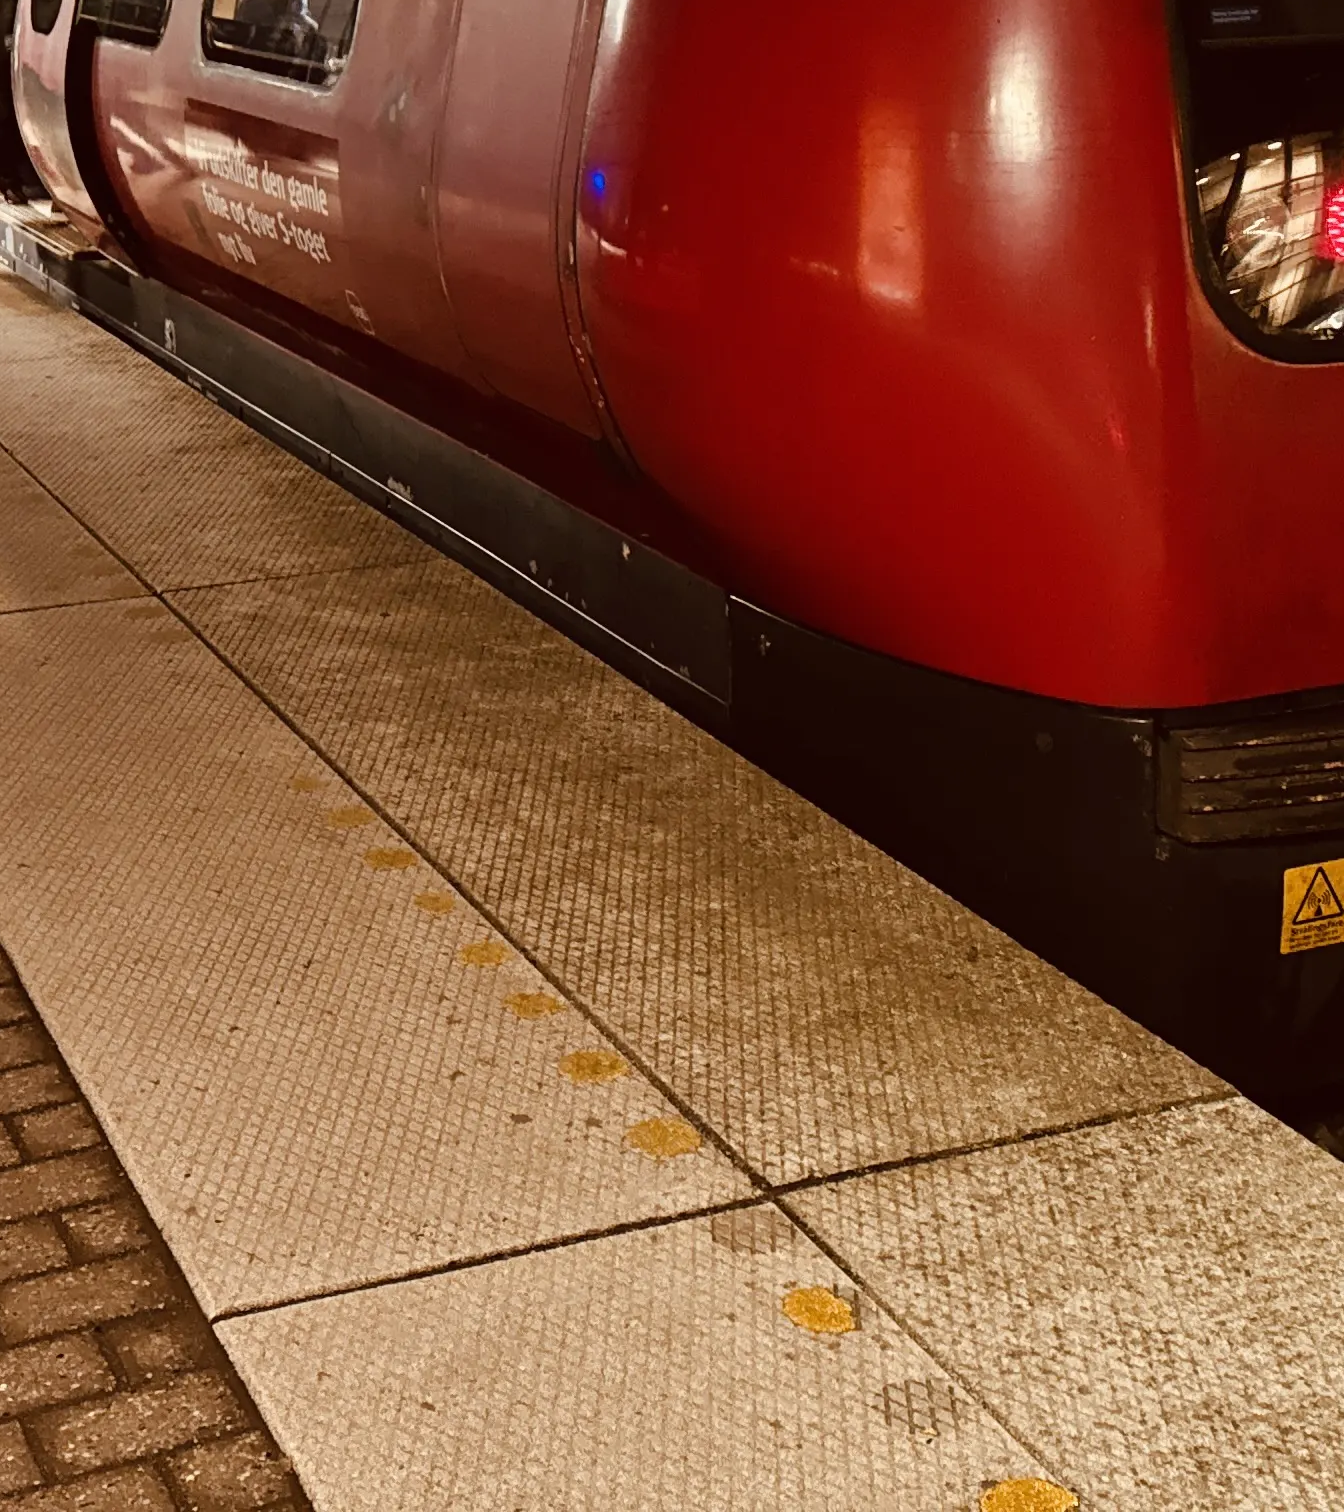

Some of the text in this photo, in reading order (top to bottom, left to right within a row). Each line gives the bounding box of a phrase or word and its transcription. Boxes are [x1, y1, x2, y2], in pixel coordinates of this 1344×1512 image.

[201, 181, 331, 264] folie og giver S-toget
[261, 160, 286, 200] den
[287, 175, 329, 216] gamle
